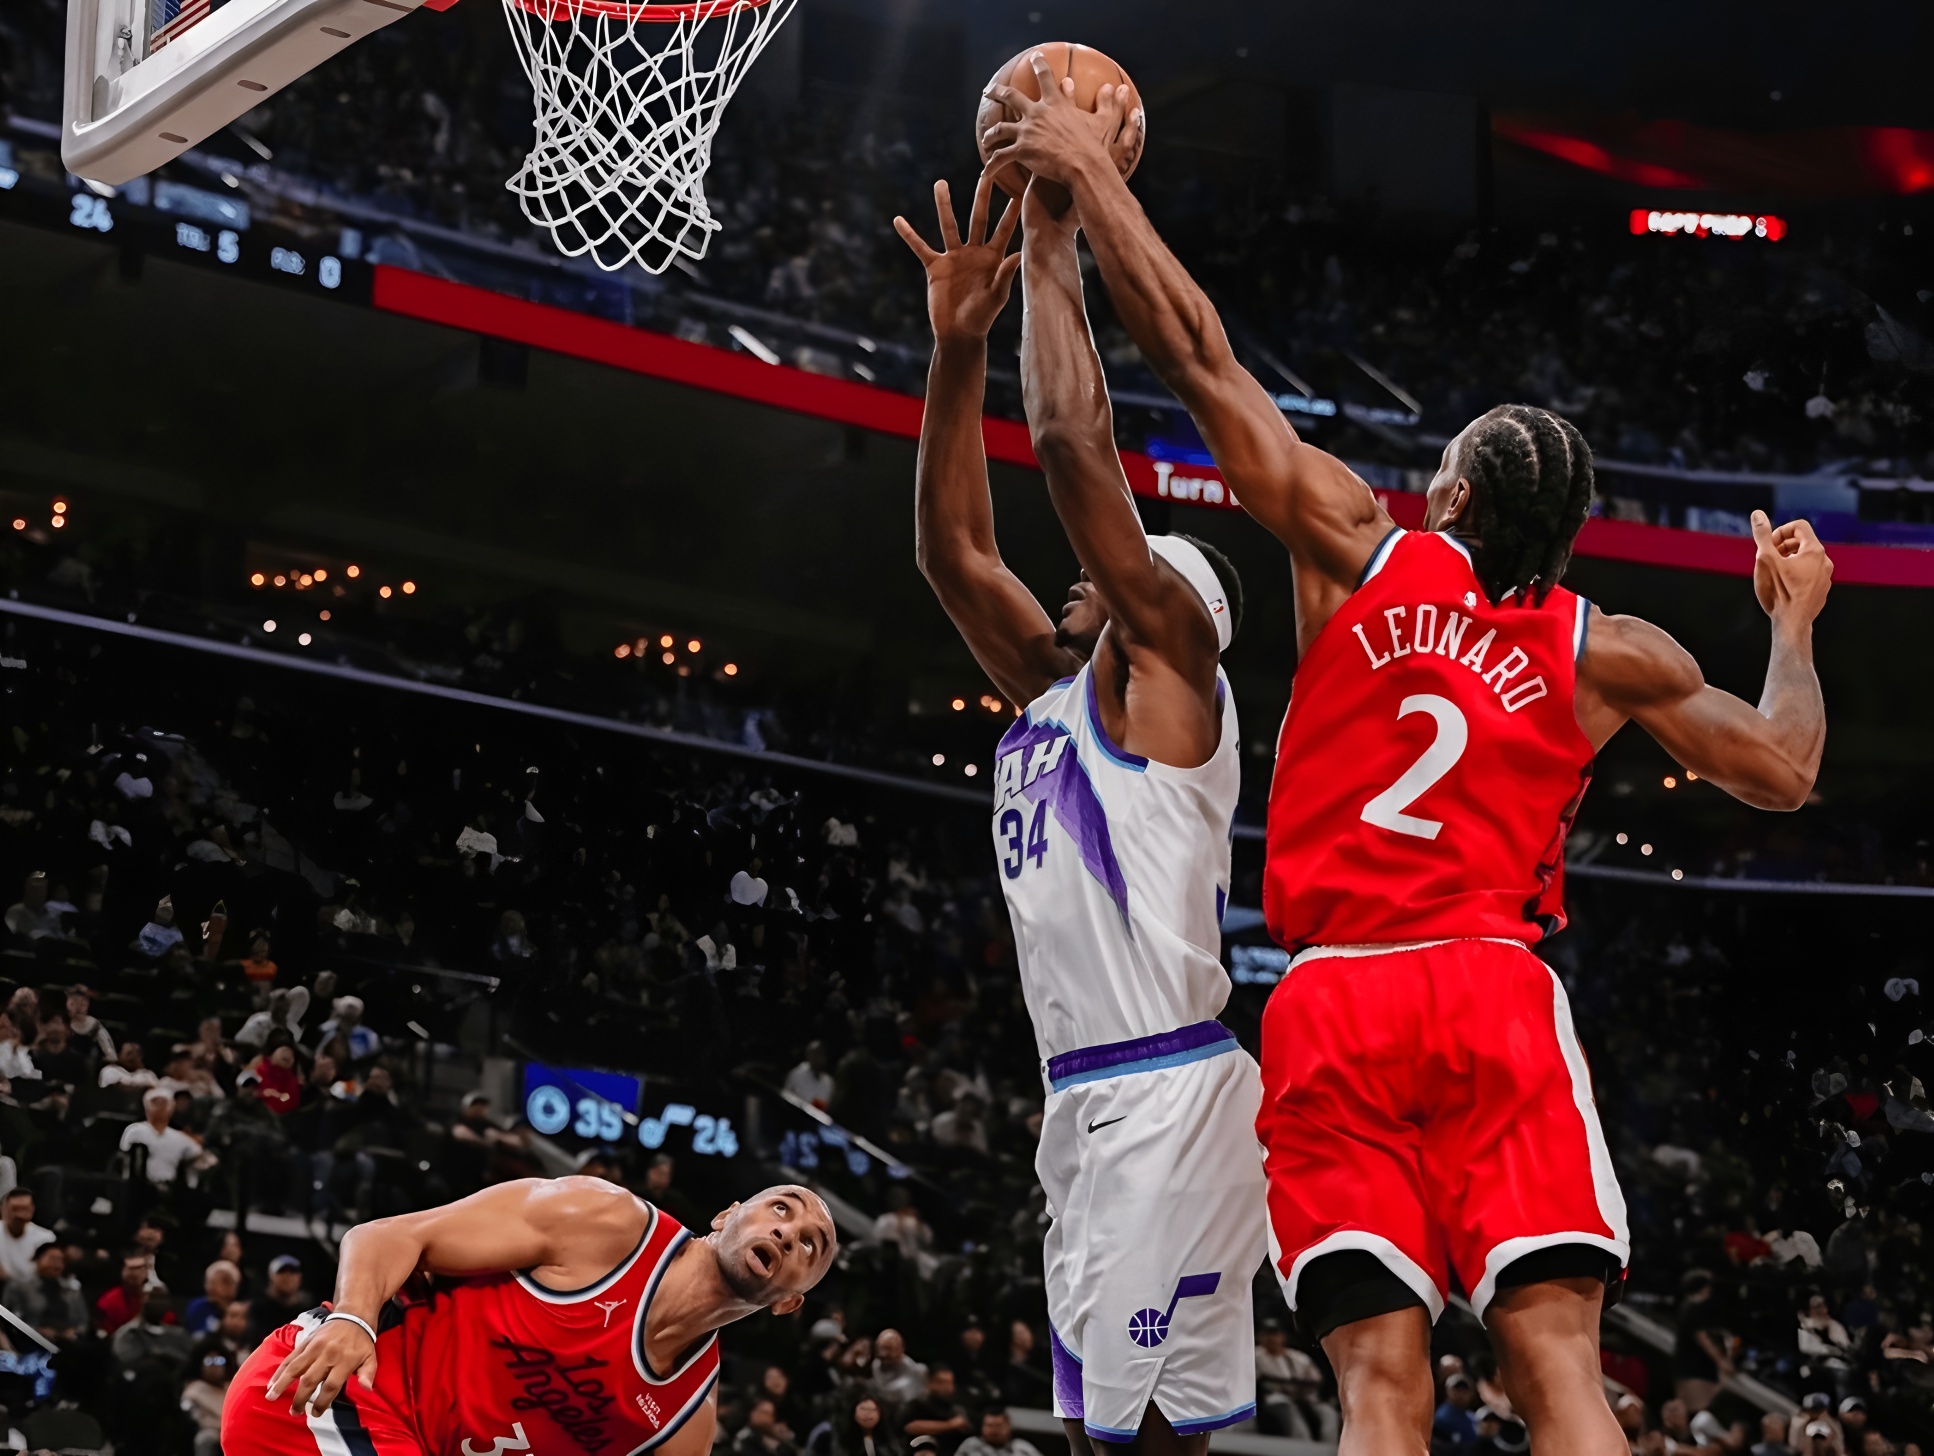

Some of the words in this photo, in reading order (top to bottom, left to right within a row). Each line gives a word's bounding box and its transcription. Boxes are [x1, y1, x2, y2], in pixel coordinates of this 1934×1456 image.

[1152, 461, 1225, 504] Turn
[1352, 603, 1548, 713] LEONARD
[993, 734, 1072, 816] AH
[1359, 693, 1469, 841] 2
[1000, 798, 1049, 880] 34
[574, 1098, 624, 1142] 35
[691, 1113, 739, 1158] 24
[490, 1334, 613, 1456] Angeles
[555, 1353, 616, 1416] Los
[460, 1421, 535, 1456] 3
